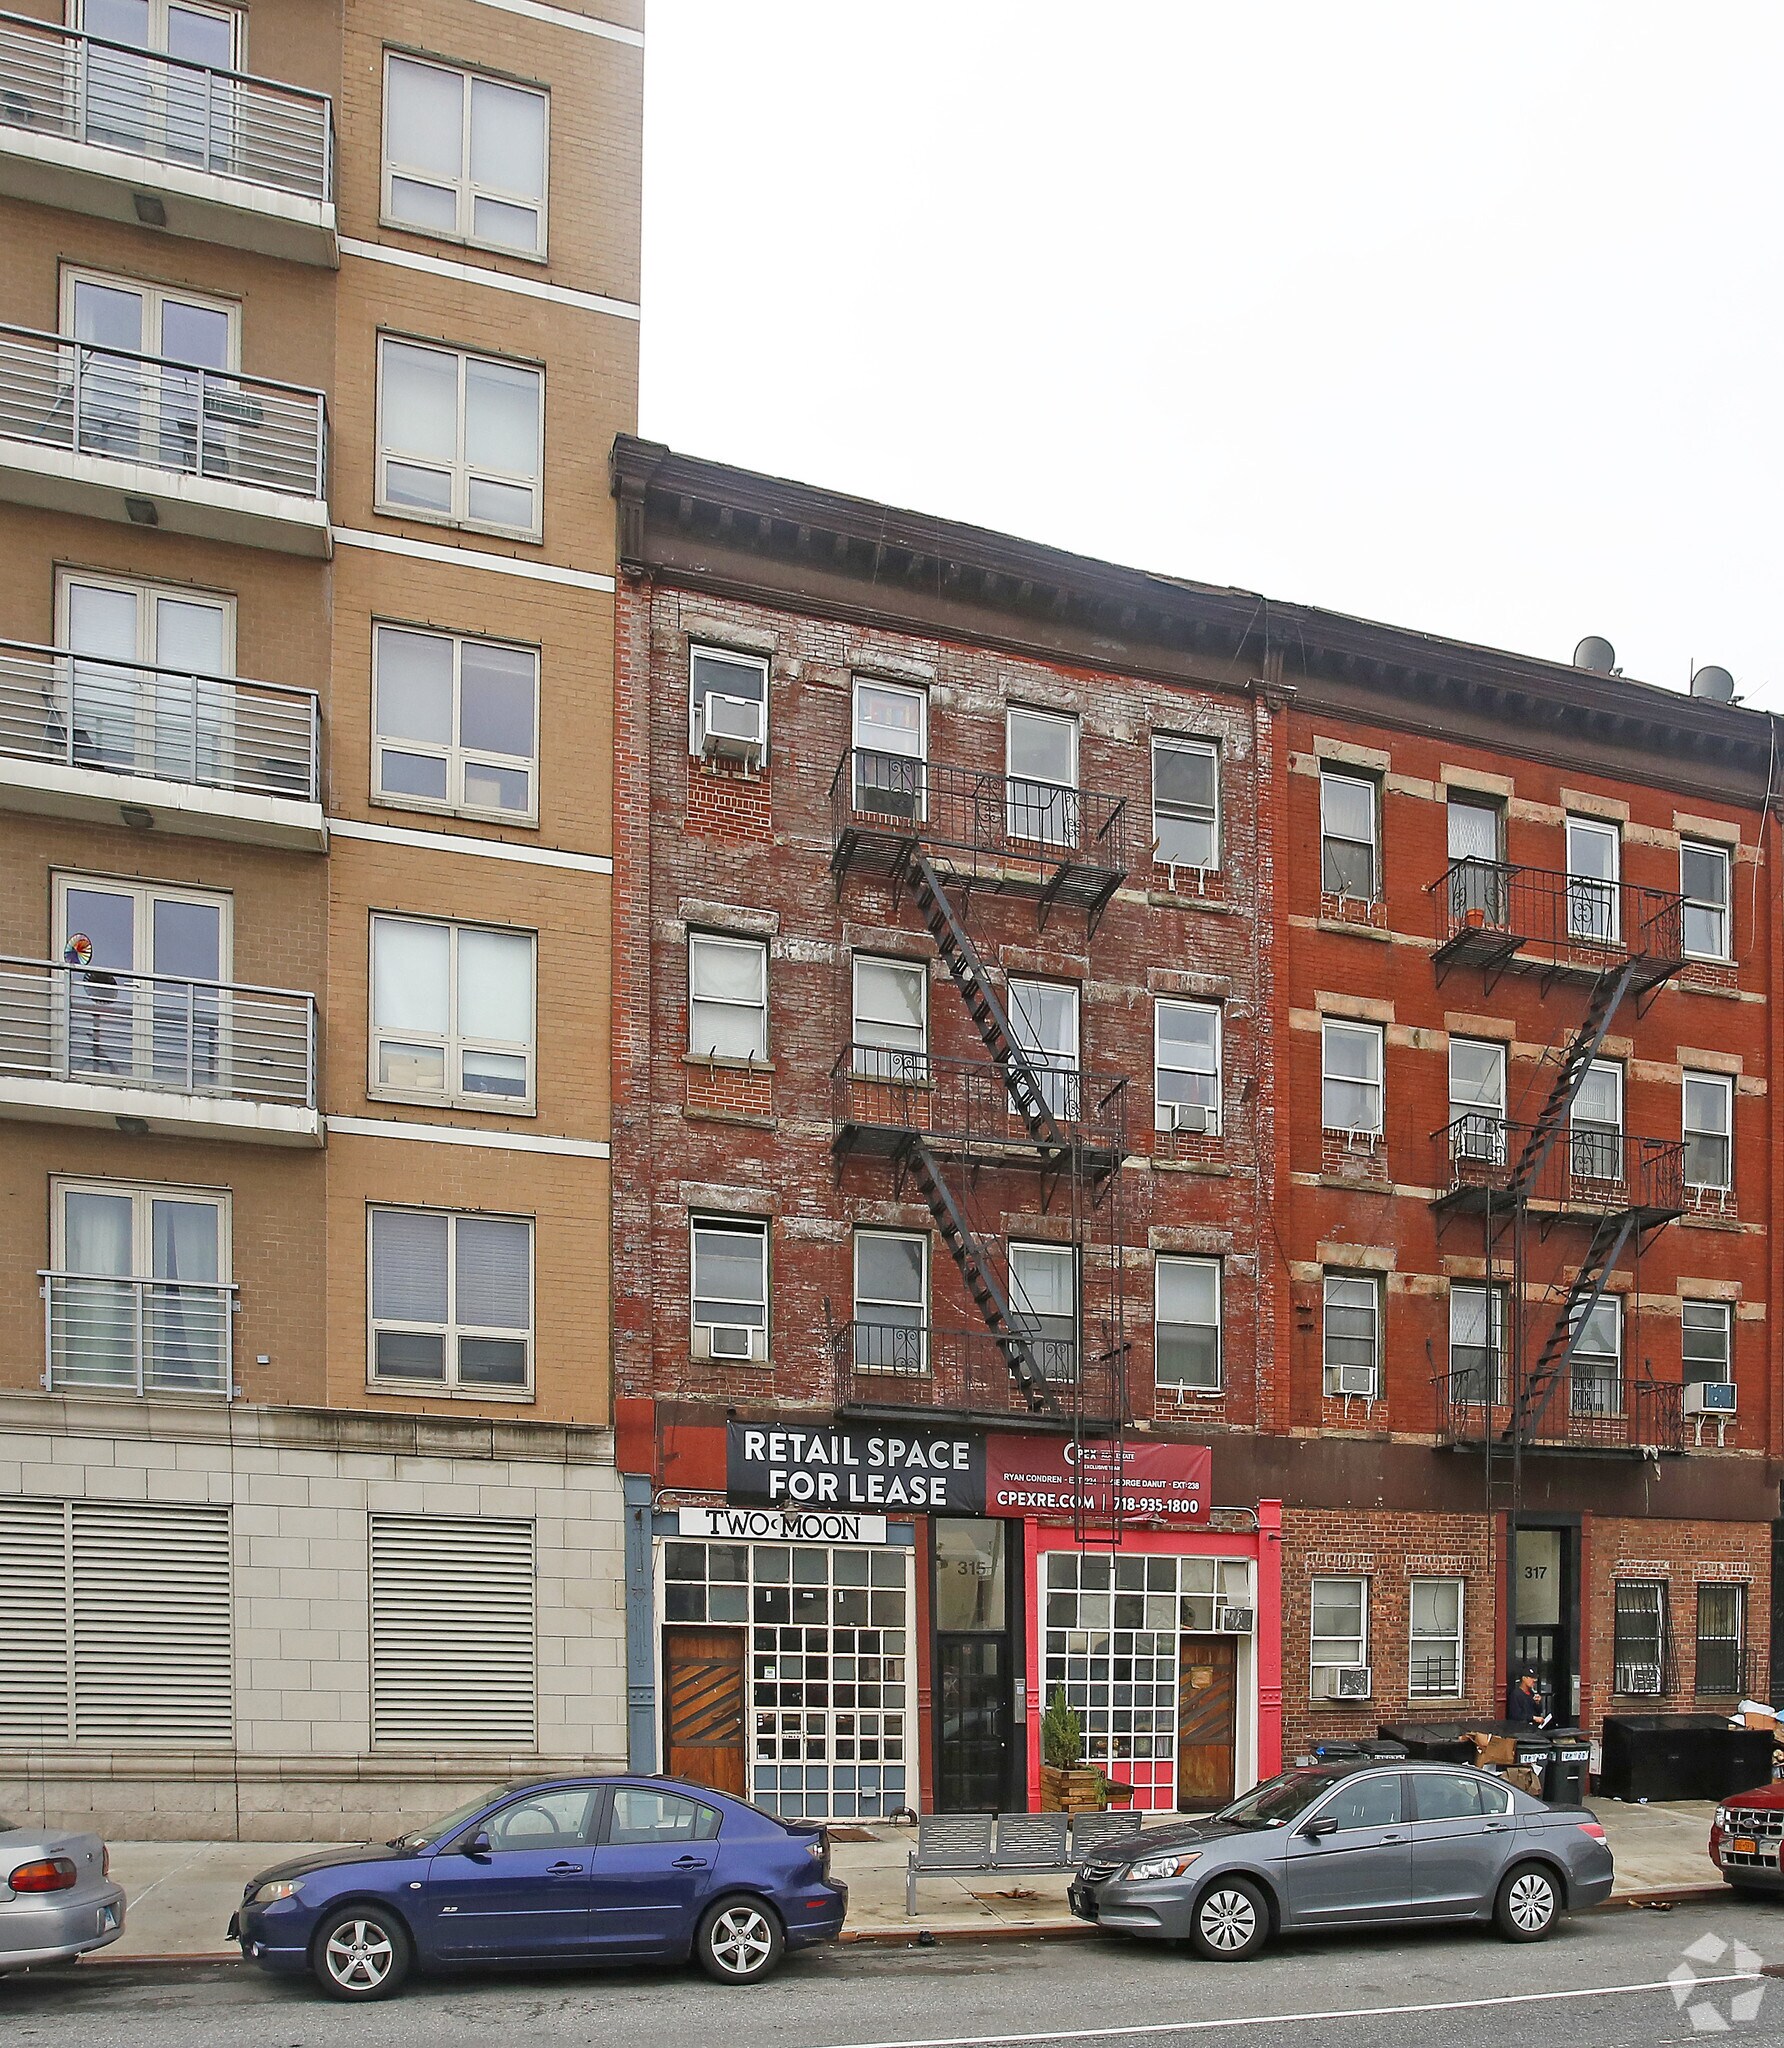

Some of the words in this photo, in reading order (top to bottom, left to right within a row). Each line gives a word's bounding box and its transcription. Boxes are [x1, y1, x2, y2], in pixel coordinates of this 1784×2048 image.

[744, 1430, 860, 1466] RETAIL
[867, 1437, 970, 1471] SPACE
[769, 1469, 839, 1502] FOR
[849, 1473, 947, 1506] LEASE
[1003, 1472, 1025, 1482] RYAN
[1026, 1474, 1062, 1484] CONDREN
[1142, 1480, 1167, 1489] DANUT
[997, 1491, 1095, 1510] CPEXRE.COM
[1113, 1496, 1199, 1514] 718-935-1800
[705, 1509, 769, 1536] TWO
[780, 1513, 861, 1540] MOON
[957, 1561, 987, 1575] 315
[1524, 1566, 1547, 1579] 317
